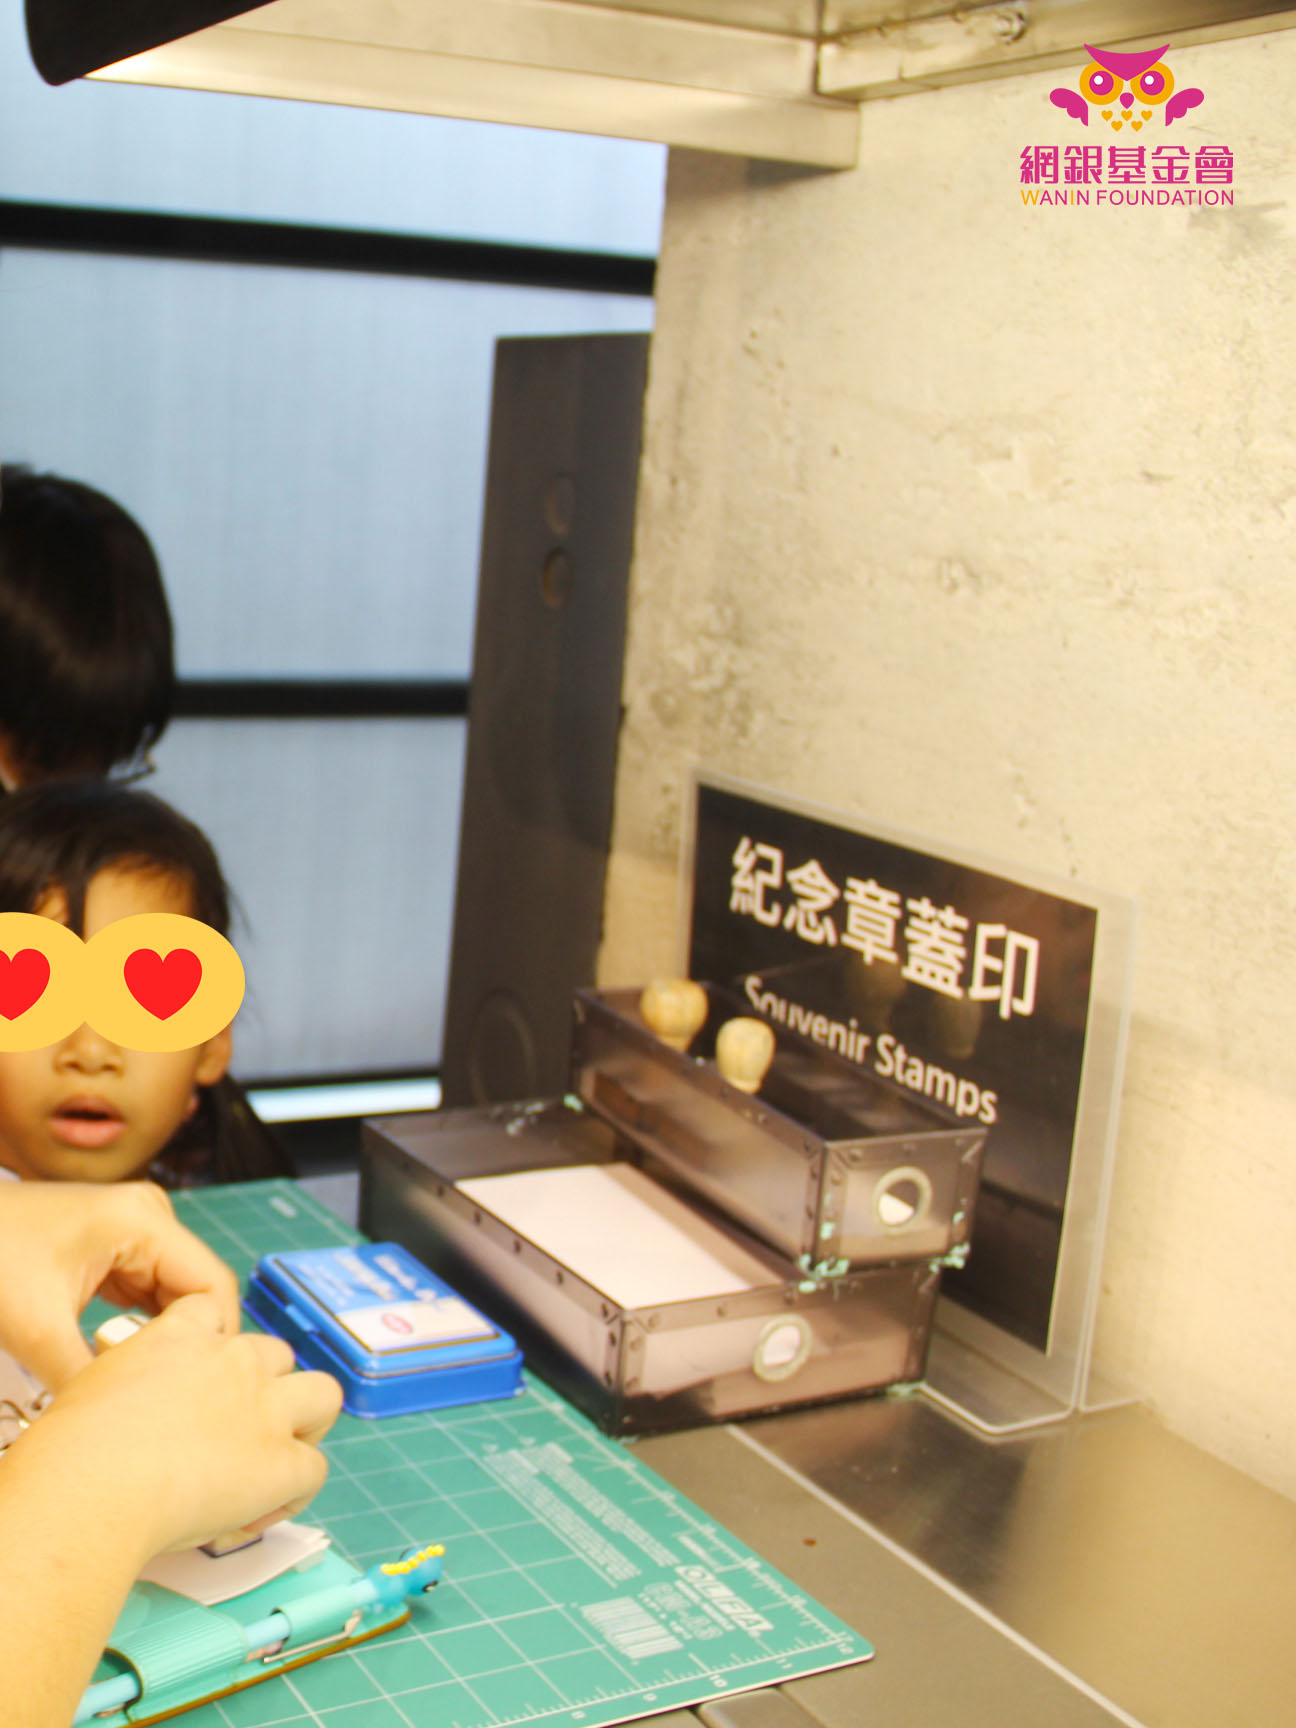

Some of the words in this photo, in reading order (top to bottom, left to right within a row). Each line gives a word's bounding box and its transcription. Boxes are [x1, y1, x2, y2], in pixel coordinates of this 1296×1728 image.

[729, 835, 1040, 1019] 紀念章蓋印
[744, 975, 871, 1064] Souvenir
[874, 1033, 998, 1124] Stamps
